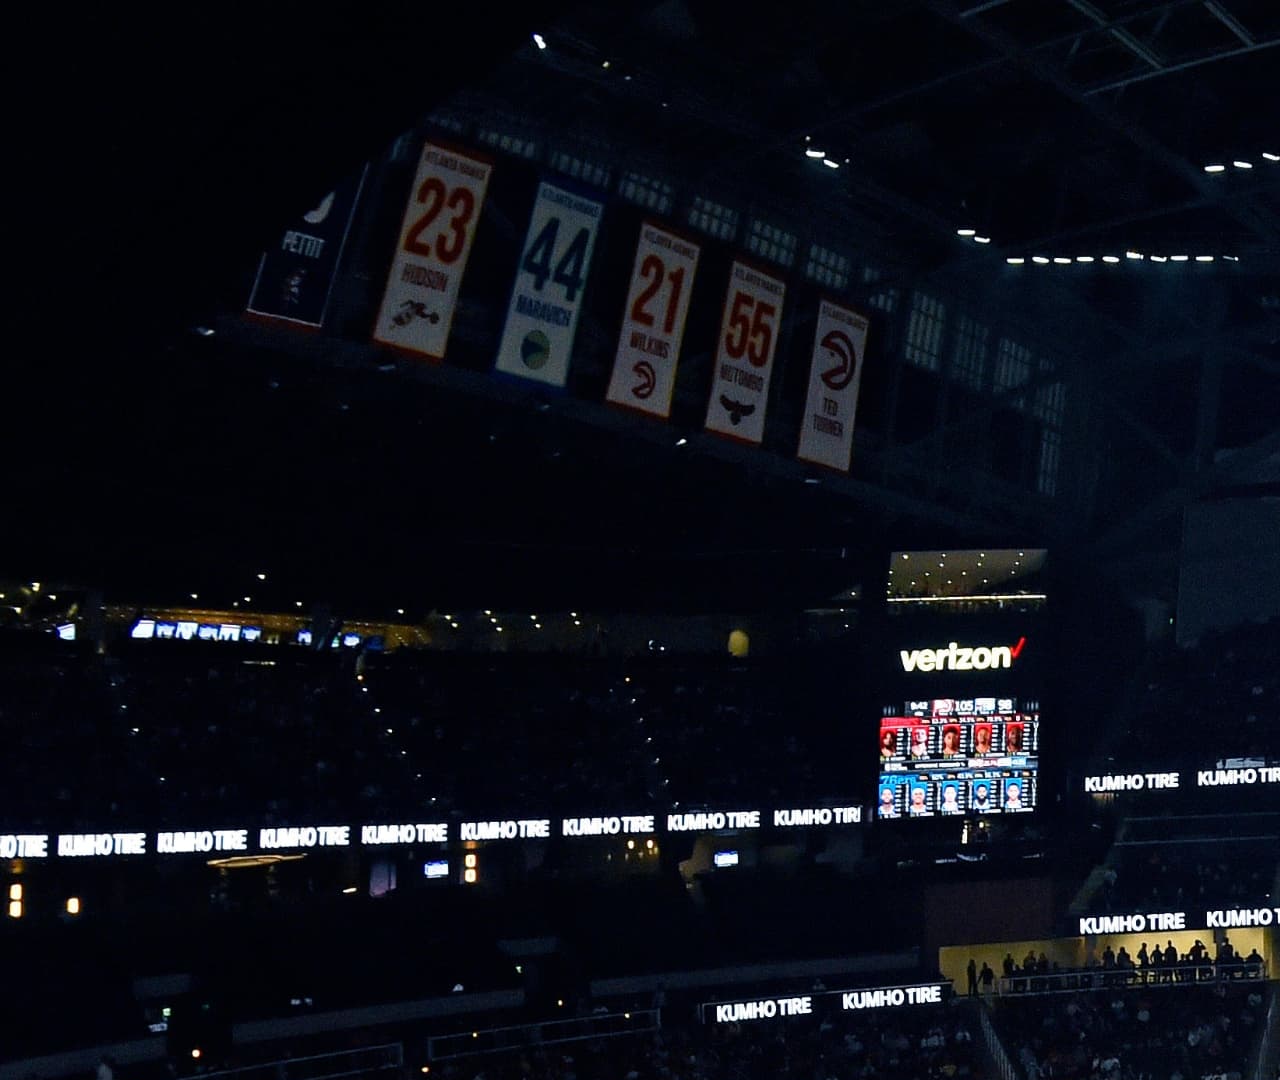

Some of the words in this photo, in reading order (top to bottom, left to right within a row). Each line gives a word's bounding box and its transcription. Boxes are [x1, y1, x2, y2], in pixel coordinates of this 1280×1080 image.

[404, 177, 474, 263] 23
[522, 217, 590, 302] 44
[400, 263, 449, 292] HUDSON
[631, 255, 684, 334] 21
[725, 291, 776, 367] 55
[900, 642, 1011, 672] verizon
[955, 701, 974, 712] 105
[998, 700, 1013, 711] 98
[1084, 774, 1144, 792] KUMHO
[1145, 772, 1180, 789] TIRE
[1197, 768, 1257, 787] KUMHO
[562, 816, 620, 836] KUMHO
[621, 815, 655, 834] TIRE
[667, 812, 725, 832] KUMHO
[726, 810, 761, 829] TIRE
[773, 808, 832, 827] KUMHO
[156, 830, 213, 854] KUMHO
[213, 829, 249, 851] TIRE
[259, 826, 317, 849] KUMHO
[317, 825, 351, 846] TIRE
[361, 823, 415, 845] KUMHO
[416, 823, 449, 843] TIRE
[460, 820, 517, 841] KUMHO
[518, 819, 550, 838] TIRE
[14, 834, 49, 858] TIRE
[57, 833, 113, 857] KUMHO
[113, 832, 147, 855] TIRE
[1079, 914, 1146, 935] KUMHO
[1147, 912, 1187, 931] TIRE
[1206, 908, 1272, 928] KUMHO
[716, 999, 776, 1023] KUMHO
[778, 996, 813, 1016] TIRE
[842, 988, 904, 1010] KUMHO
[905, 985, 942, 1005] TIRE
